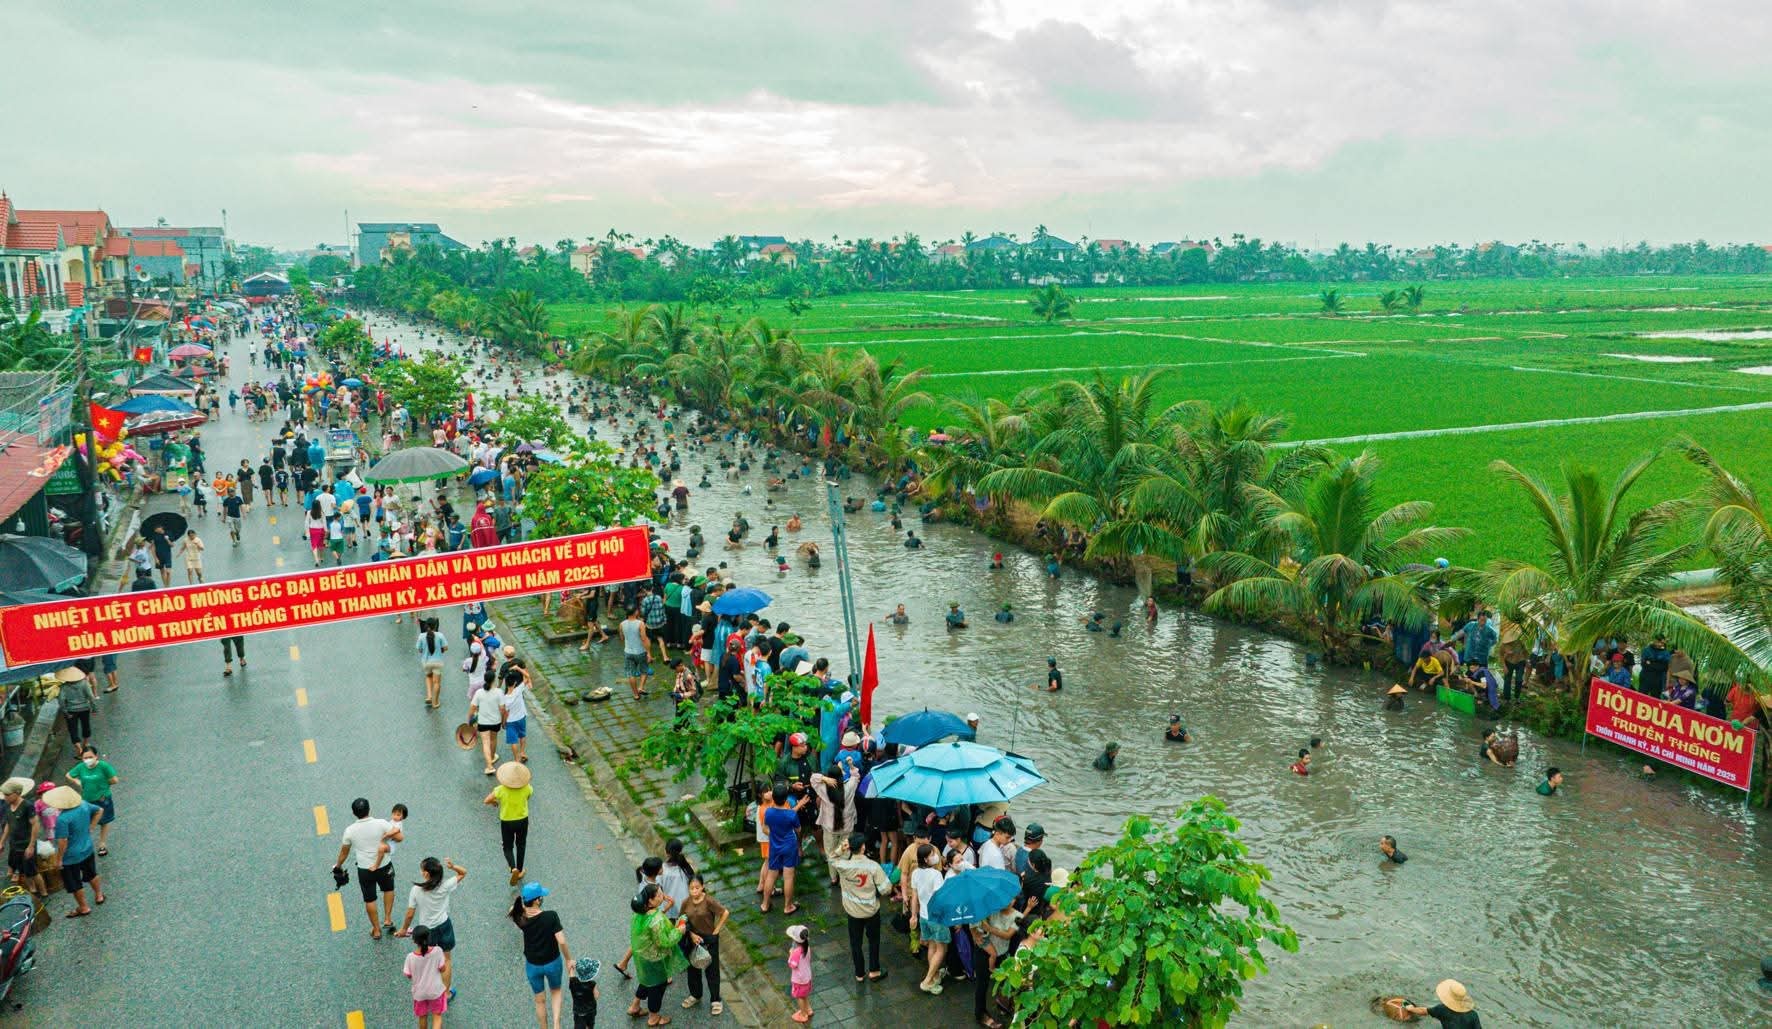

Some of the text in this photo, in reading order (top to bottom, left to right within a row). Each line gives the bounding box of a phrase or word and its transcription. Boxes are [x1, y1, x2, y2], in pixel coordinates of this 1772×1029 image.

[34, 536, 624, 629] NHIỆT LIỆT CHÀO MỪNG CÁC ĐẠI BIỂU, NHÂN DÂN VÀ DU KHÁCH VỀ DỰ HỘI
[68, 631, 107, 650] ĐÙA
[111, 625, 154, 644] NƠM
[158, 612, 227, 638] TRUYỀN
[231, 605, 287, 628] THỐNG
[291, 600, 335, 619] THÔN
[339, 593, 392, 612] THANH
[426, 583, 447, 600] XÃ
[452, 576, 477, 597] CHÍ
[482, 575, 521, 593] MINH
[526, 569, 560, 587] NĂM
[564, 564, 604, 582] 2025!
[1596, 688, 1744, 754] HỘI ĐÙA NƠM
[1668, 736, 1720, 763] THỐNG
[1716, 768, 1737, 781] 2025
